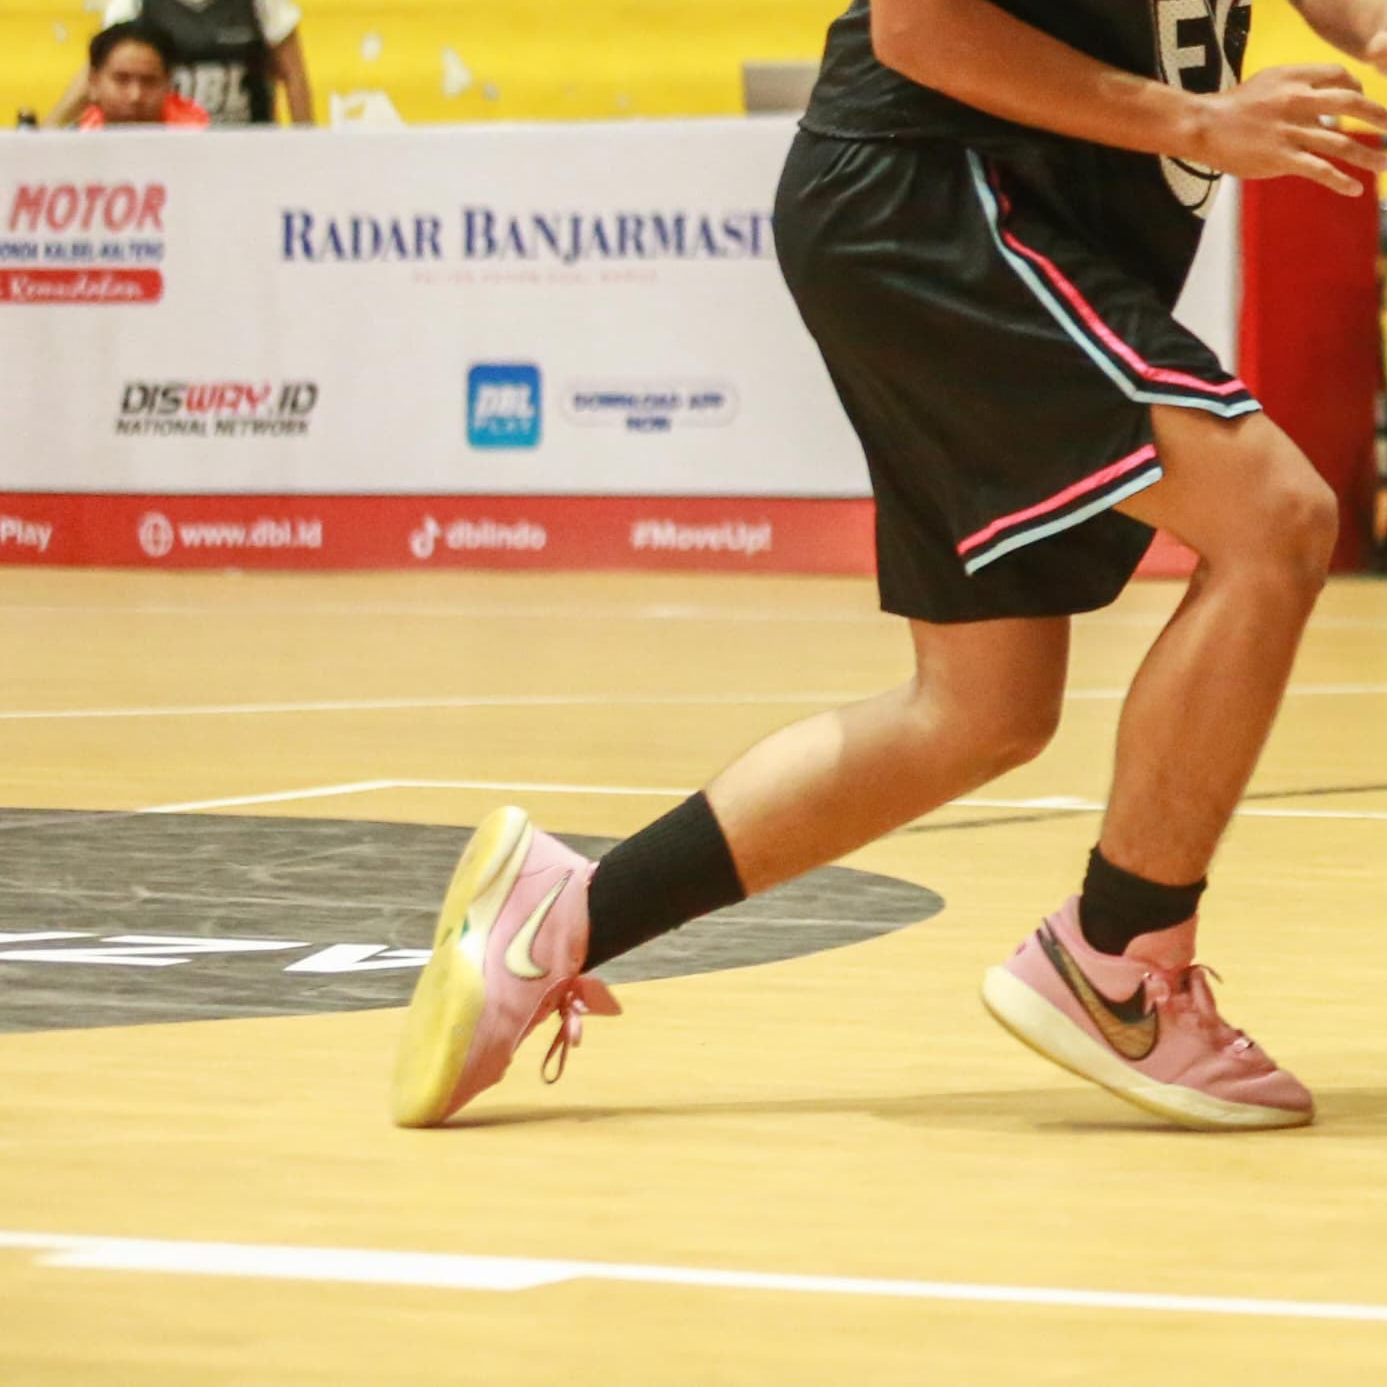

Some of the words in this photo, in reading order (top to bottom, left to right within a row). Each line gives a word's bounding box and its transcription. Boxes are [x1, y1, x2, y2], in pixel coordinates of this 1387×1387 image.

[8, 184, 167, 233] MOTOR
[462, 210, 777, 264] BANJARMASI
[115, 419, 208, 436] NATIONAL
[214, 419, 310, 436] NETWORK
[180, 518, 323, 548] www.dbl.id
[446, 520, 547, 550] dblindo
[631, 518, 772, 556] #MoveUp!
